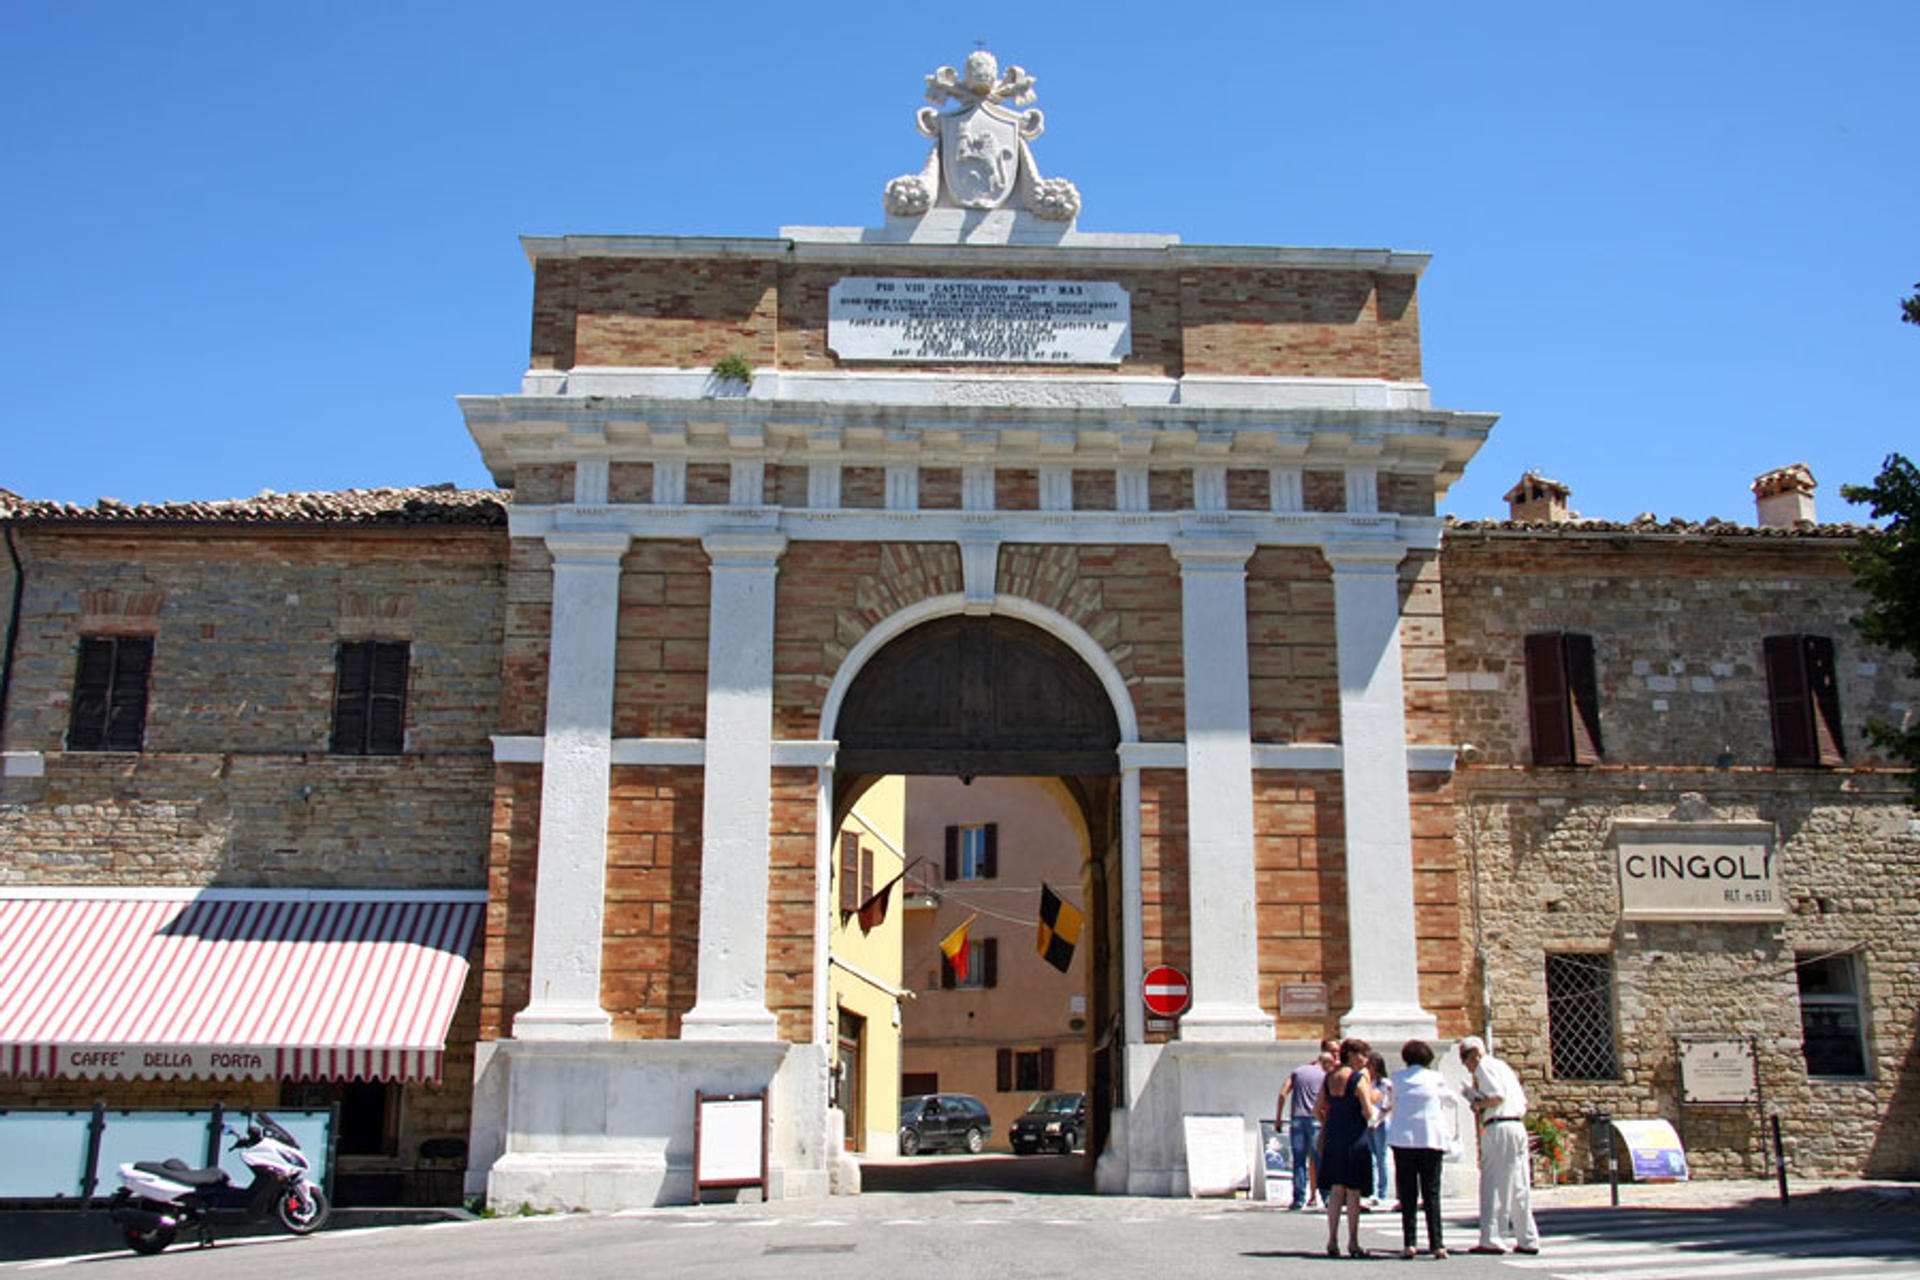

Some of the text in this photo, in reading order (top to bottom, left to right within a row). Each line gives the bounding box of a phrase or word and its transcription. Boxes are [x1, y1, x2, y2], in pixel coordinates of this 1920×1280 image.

[904, 283, 925, 293] VIII
[1017, 285, 1046, 295] PONT
[1625, 854, 1770, 880] CINGOLI
[143, 1052, 193, 1068] DELLA
[210, 1053, 262, 1068] PORTA
